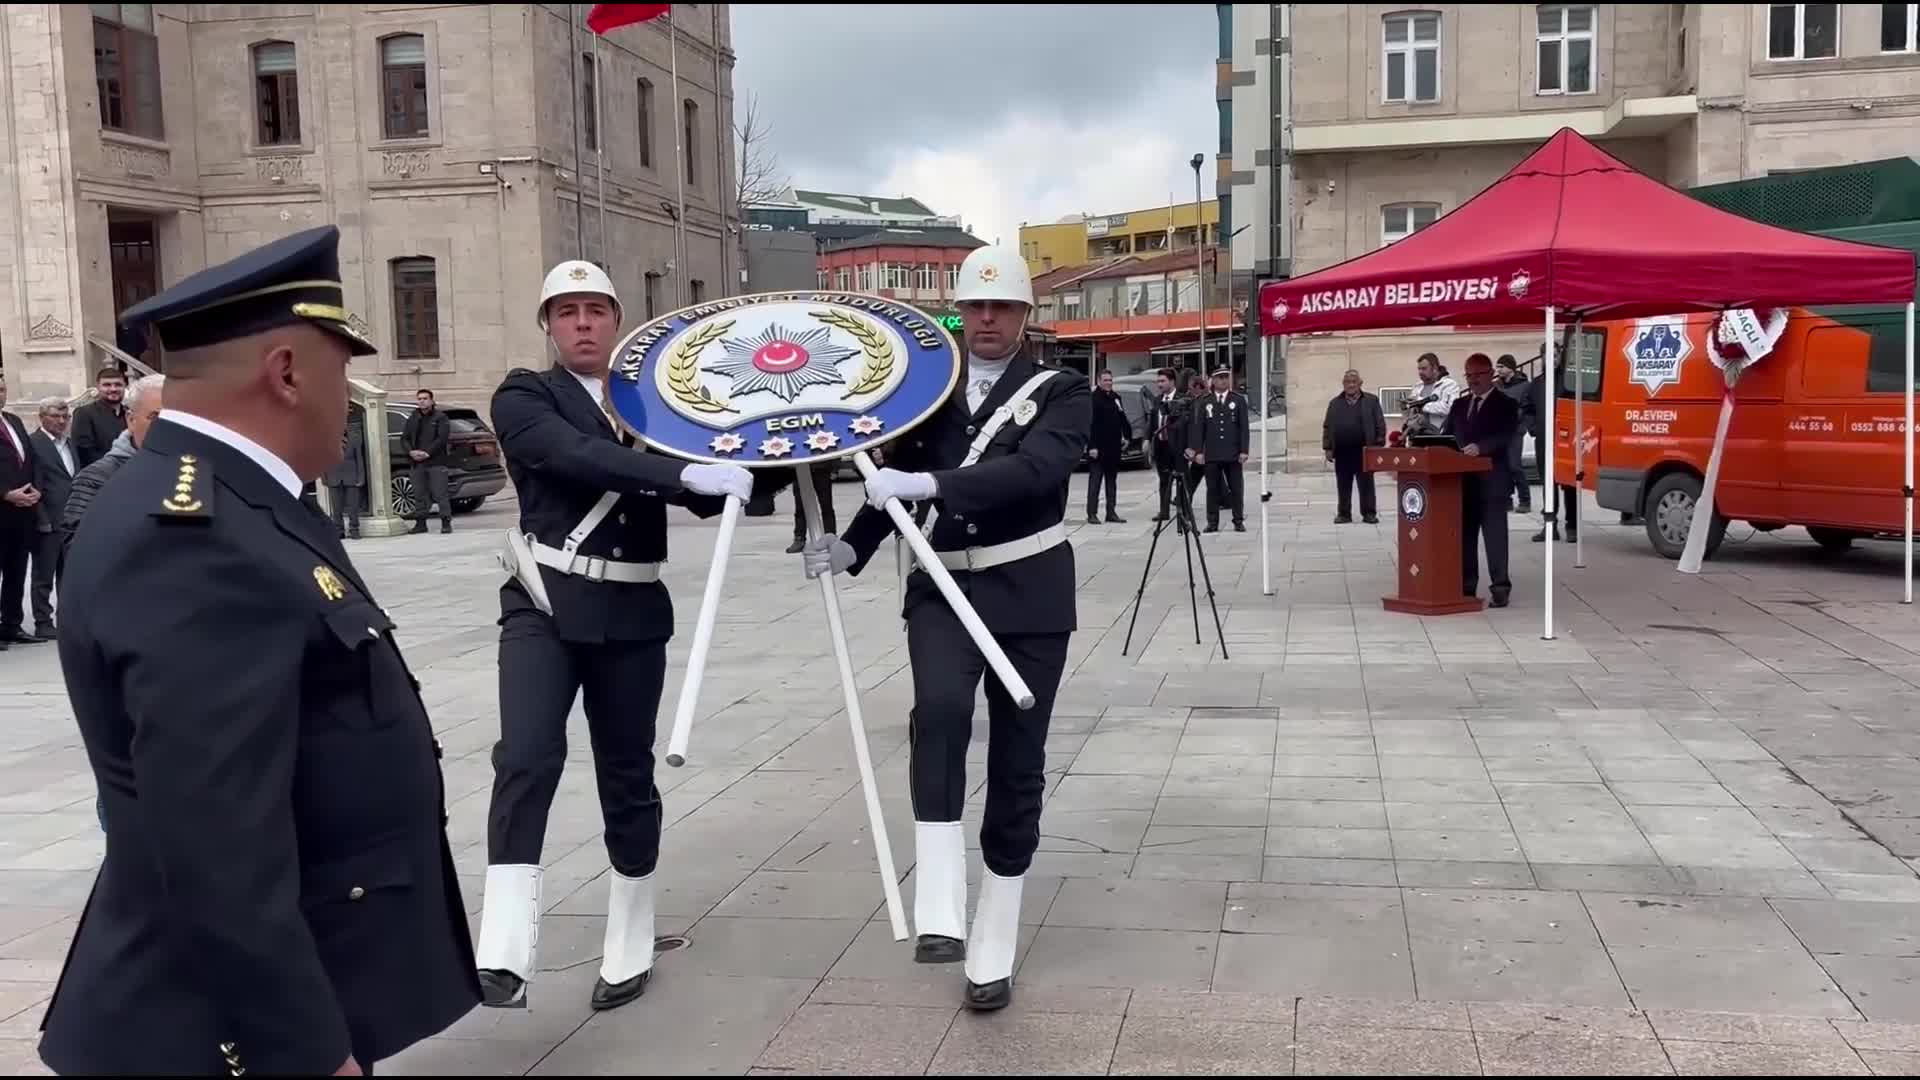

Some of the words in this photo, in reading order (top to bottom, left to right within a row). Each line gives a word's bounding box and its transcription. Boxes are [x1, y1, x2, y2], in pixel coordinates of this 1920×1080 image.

[1300, 286, 1380, 313] AKSARAY
[620, 320, 673, 381] AKSARAY
[1636, 360, 1676, 370] AKSARAY
[765, 413, 825, 432] EGM
